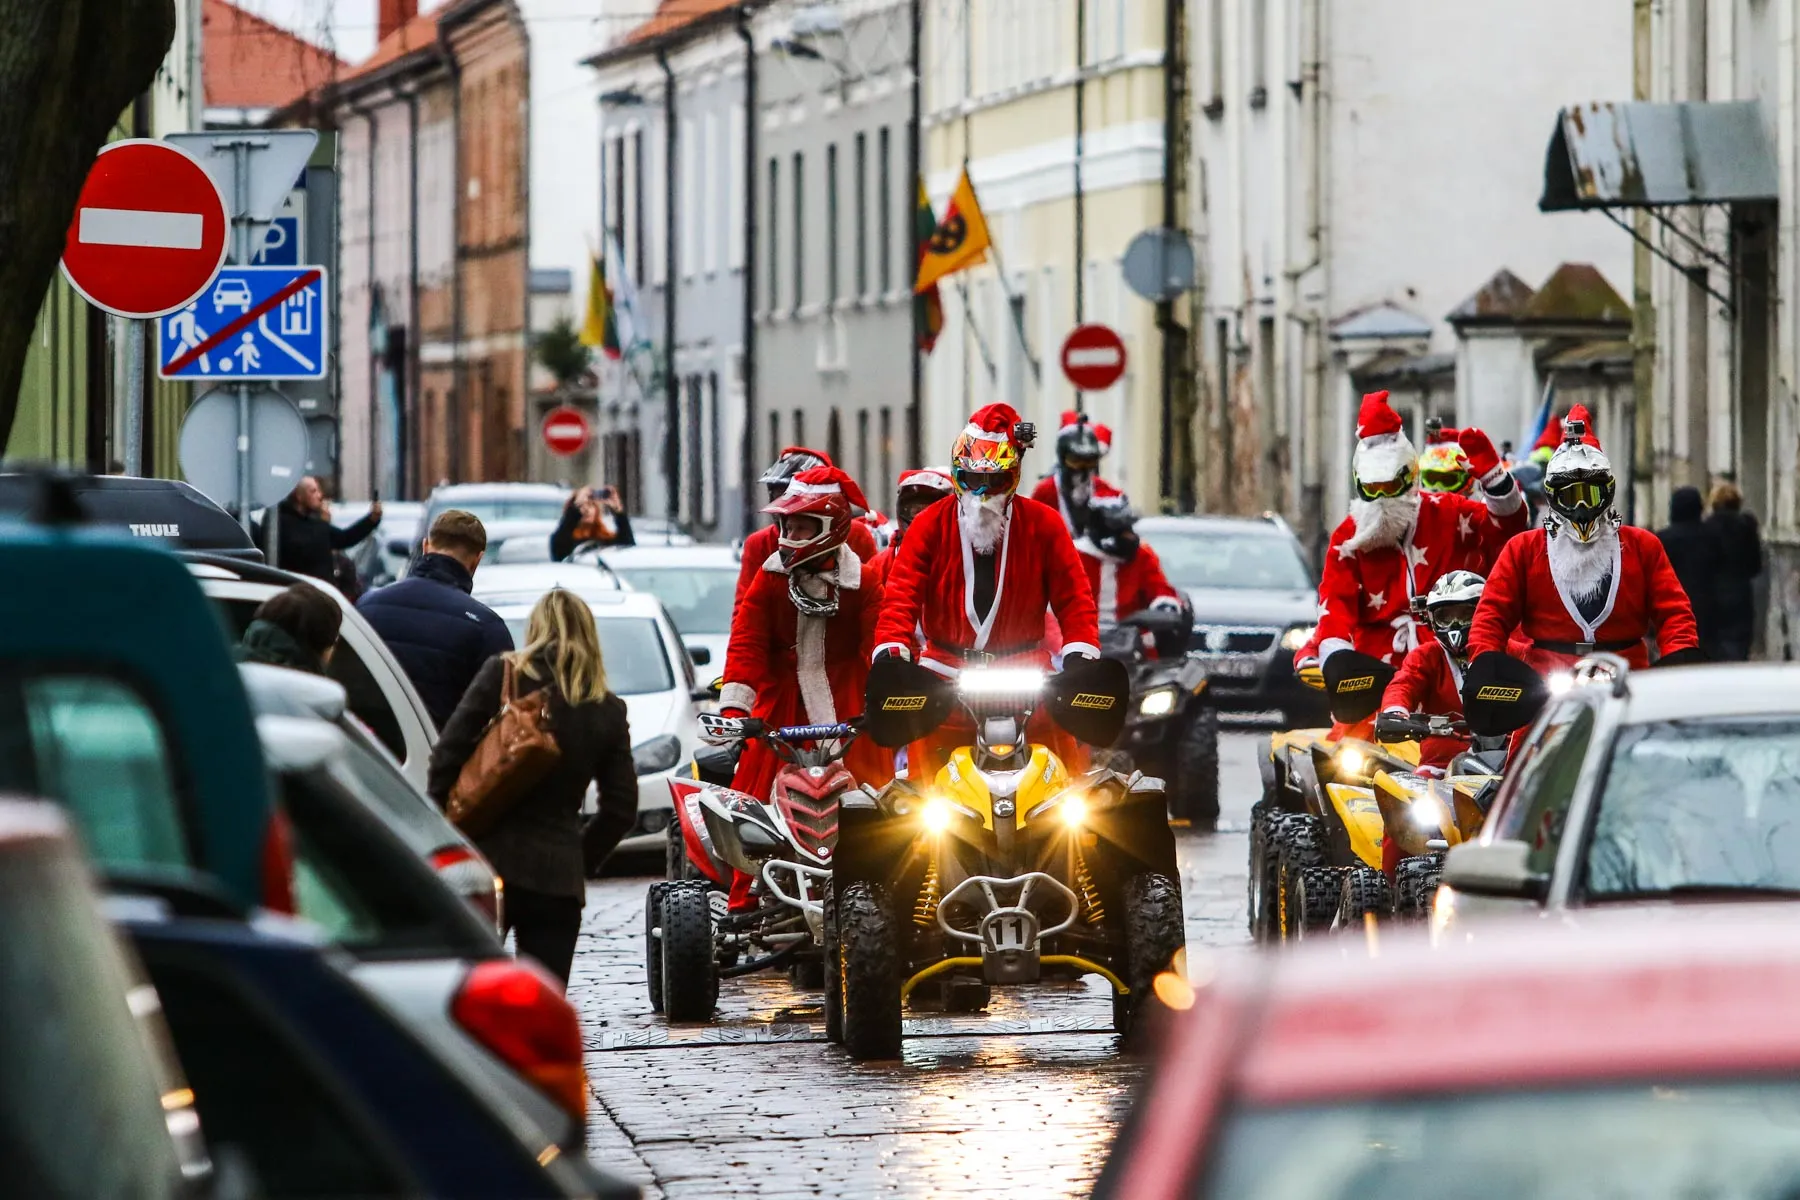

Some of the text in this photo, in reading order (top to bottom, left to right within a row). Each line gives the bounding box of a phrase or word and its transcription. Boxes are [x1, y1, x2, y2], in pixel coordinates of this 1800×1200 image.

[129, 524, 180, 537] THULE
[1340, 678, 1373, 689] MOOSE
[1480, 687, 1521, 698] MOOSE
[886, 698, 926, 707] MOOSE
[1075, 694, 1114, 706] MOOSE
[783, 725, 842, 737] YAMAHA
[990, 918, 1023, 945] 11
